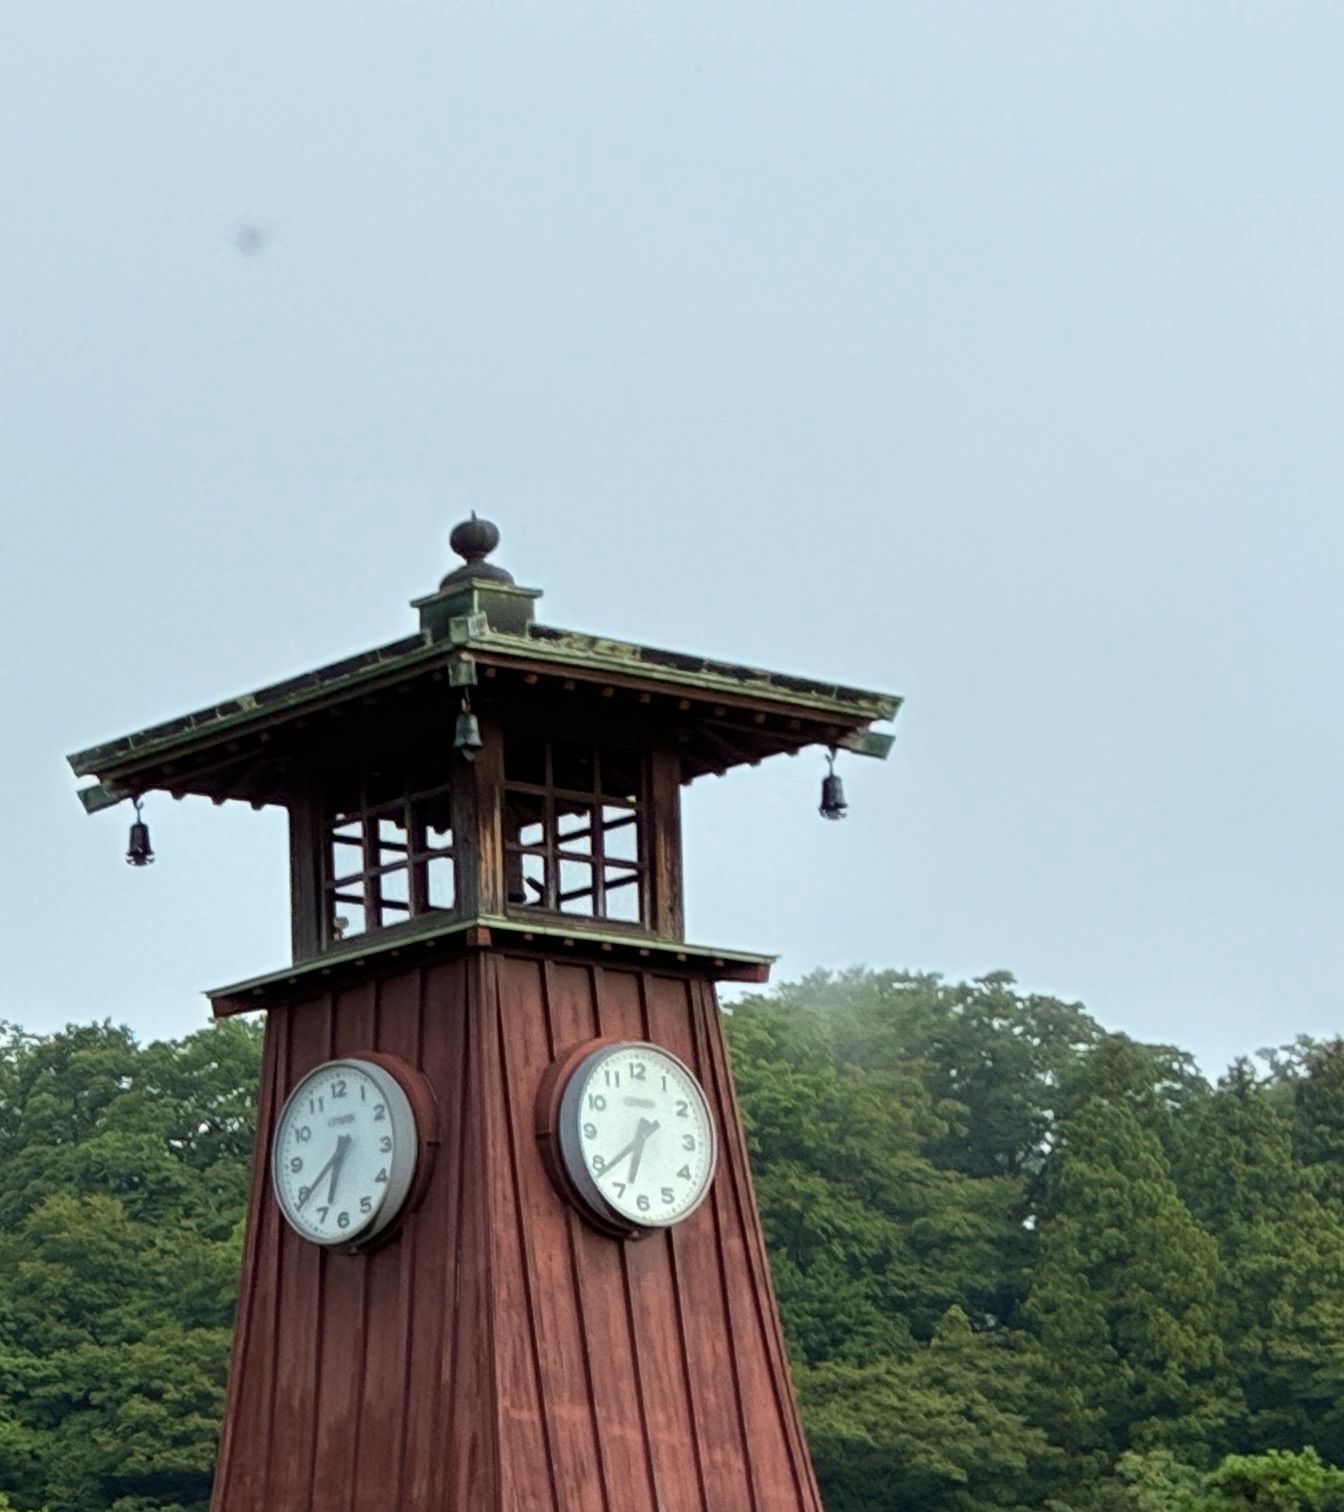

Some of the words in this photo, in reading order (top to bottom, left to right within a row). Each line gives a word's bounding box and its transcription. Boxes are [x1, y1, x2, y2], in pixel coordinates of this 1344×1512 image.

[604, 1070, 620, 1088] 11
[629, 1062, 647, 1081] 12
[331, 1080, 347, 1099] 12
[661, 1074, 667, 1092] 1
[360, 1085, 366, 1101] 1
[309, 1096, 324, 1114] 11
[587, 1093, 607, 1112] 10
[675, 1100, 689, 1119] 2
[373, 1104, 386, 1122] 2
[294, 1125, 312, 1144] 10
[583, 1122, 598, 1140] 9
[379, 1136, 392, 1153] 3
[681, 1134, 696, 1151] 3
[290, 1156, 304, 1174] 9
[591, 1154, 606, 1171] 8
[374, 1167, 388, 1184] 4
[676, 1163, 692, 1182] 4
[298, 1186, 311, 1202] 8
[612, 1182, 627, 1200] 7
[660, 1187, 675, 1204] 5
[360, 1196, 372, 1214] 5
[636, 1194, 651, 1212] 6
[316, 1206, 330, 1225] 7
[337, 1211, 350, 1229] 6
